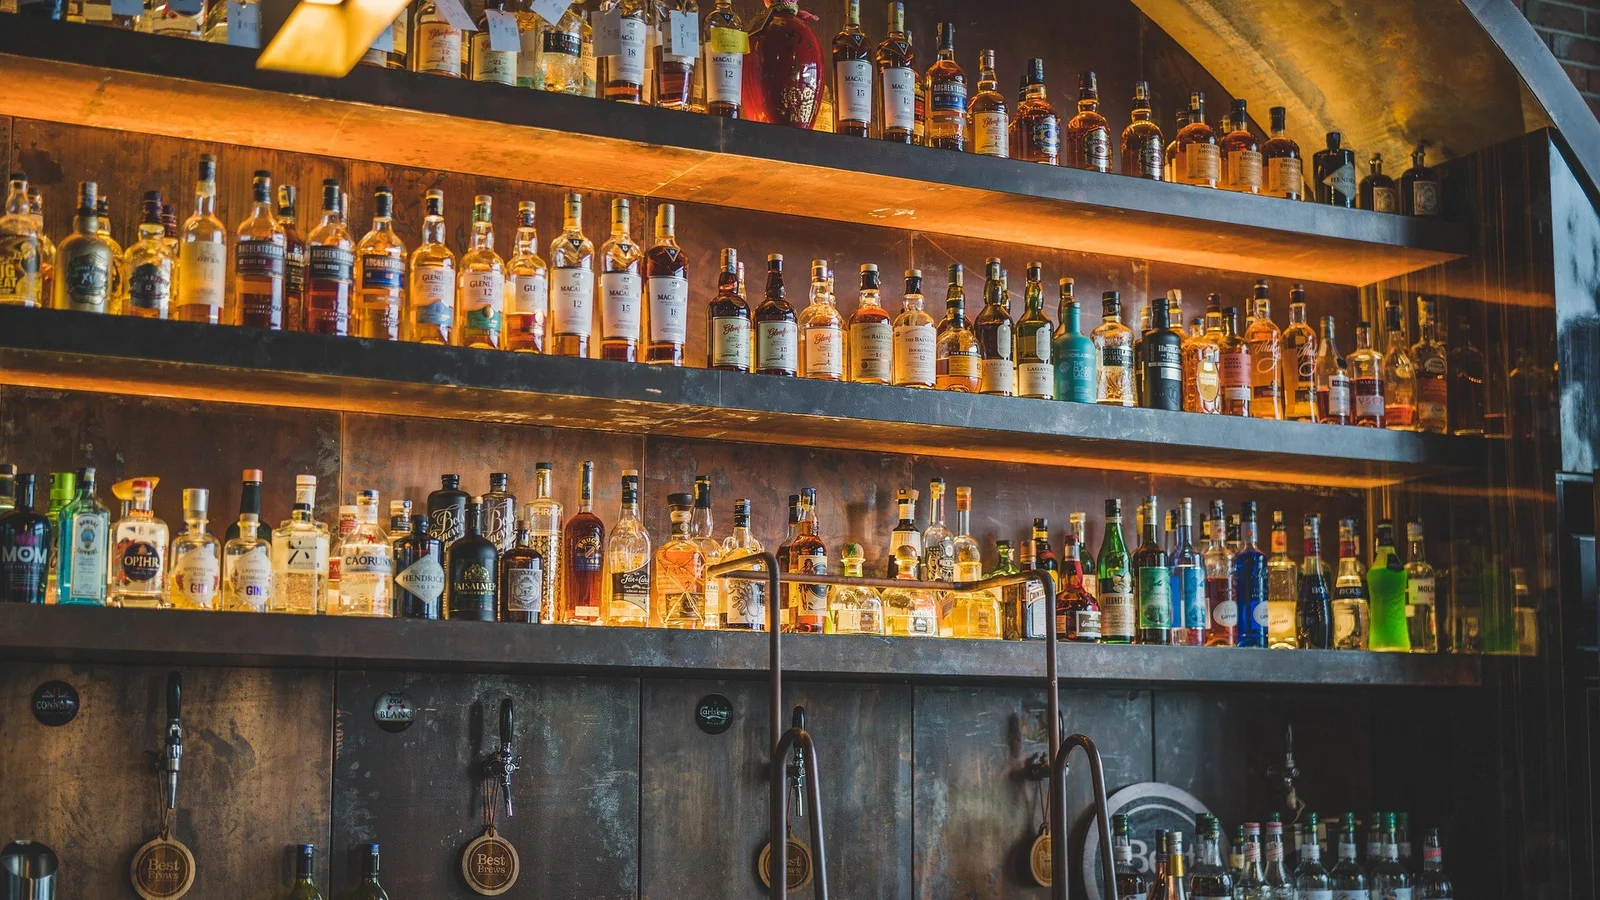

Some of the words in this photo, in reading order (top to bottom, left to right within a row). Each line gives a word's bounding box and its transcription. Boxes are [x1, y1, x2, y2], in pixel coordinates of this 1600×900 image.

[627, 48, 636, 56] 18
[724, 70, 733, 78] 12
[857, 89, 865, 97] 15
[903, 97, 911, 105] 12
[0, 264, 15, 278] IG
[483, 288, 493, 296] 12
[573, 300, 582, 308] 12
[622, 304, 631, 313] 15
[531, 507, 562, 516] PHRAA
[2, 546, 48, 564] MOM
[124, 555, 160, 568] OPIHR
[402, 575, 444, 583] HENDRICK
[245, 585, 262, 596] GIN
[1339, 587, 1362, 595] BOLS
[380, 709, 412, 719] BLANC
[477, 853, 506, 866] Best
[786, 856, 801, 867] est
[147, 858, 180, 871] Best
[477, 865, 506, 874] Brews
[147, 870, 179, 880] Brews
